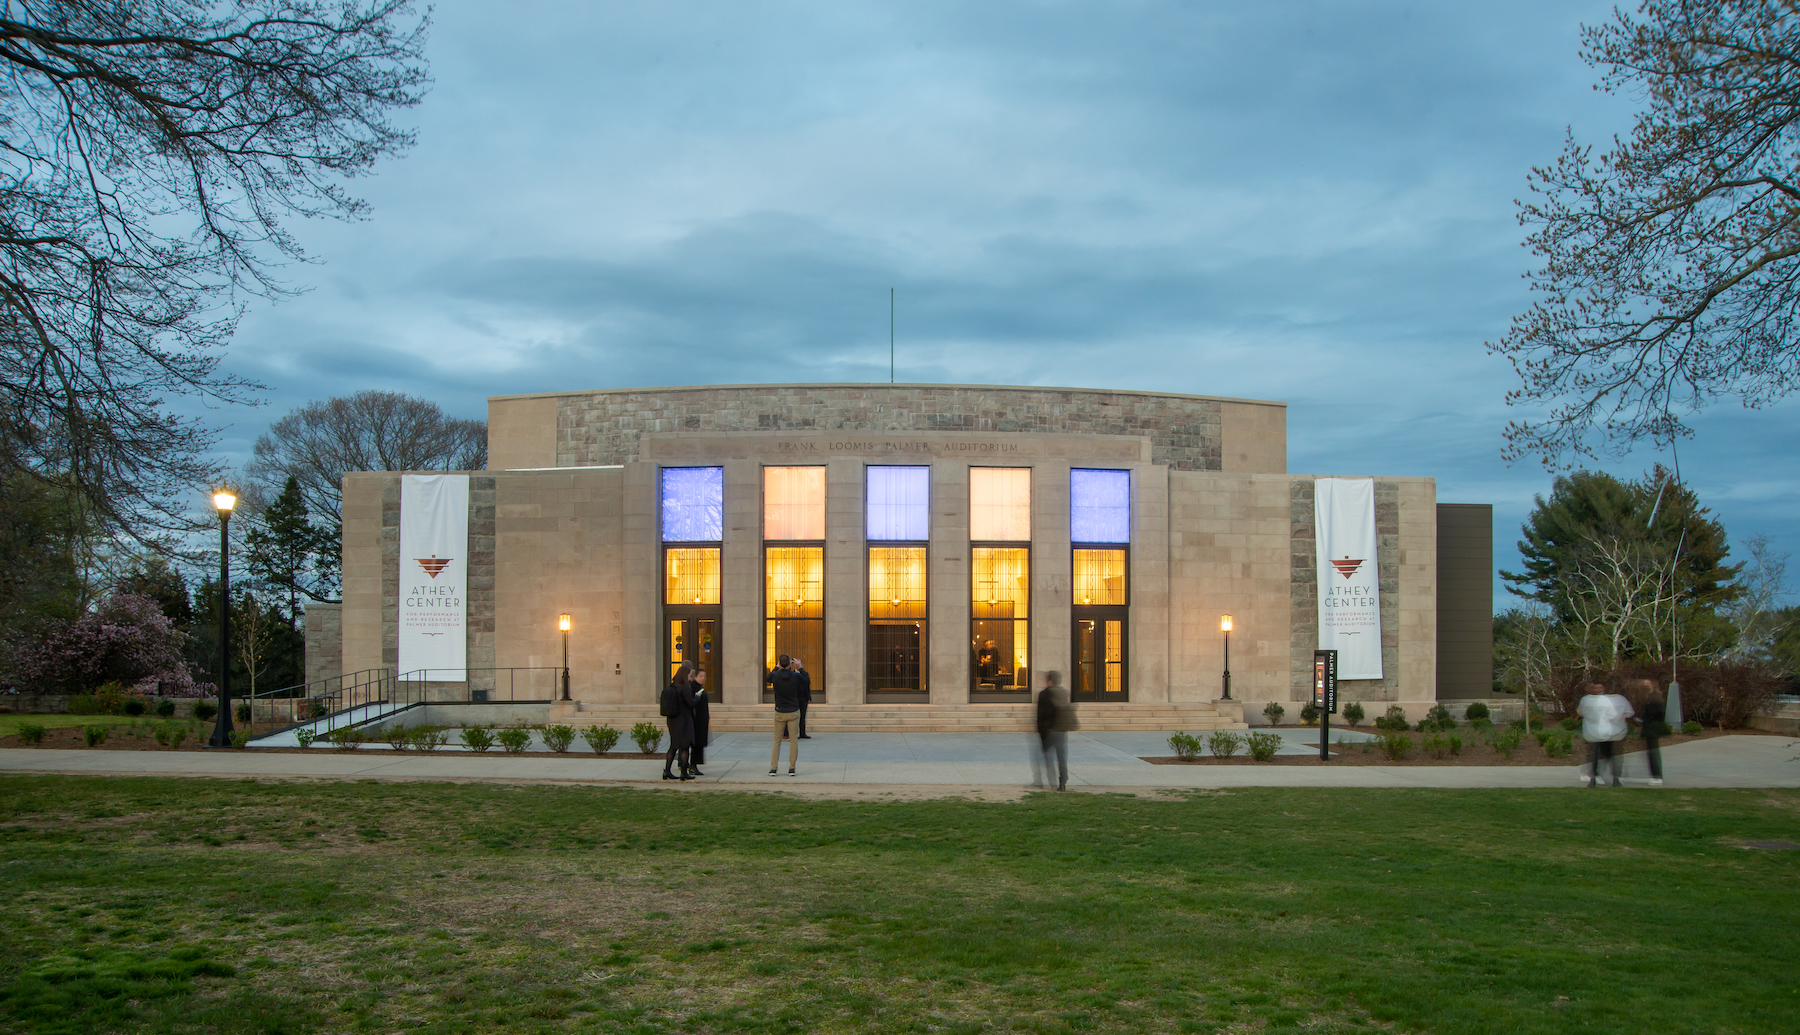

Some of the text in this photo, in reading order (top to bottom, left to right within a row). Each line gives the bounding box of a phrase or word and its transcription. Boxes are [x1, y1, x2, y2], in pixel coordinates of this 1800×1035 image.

[778, 442, 1018, 452] FRANK LOOMIS PALMER AUDITORIUM
[412, 586, 455, 595] ATHEY
[1328, 586, 1370, 595] ATHEY
[406, 598, 460, 607] CENTER
[1325, 598, 1375, 607] CENTER
